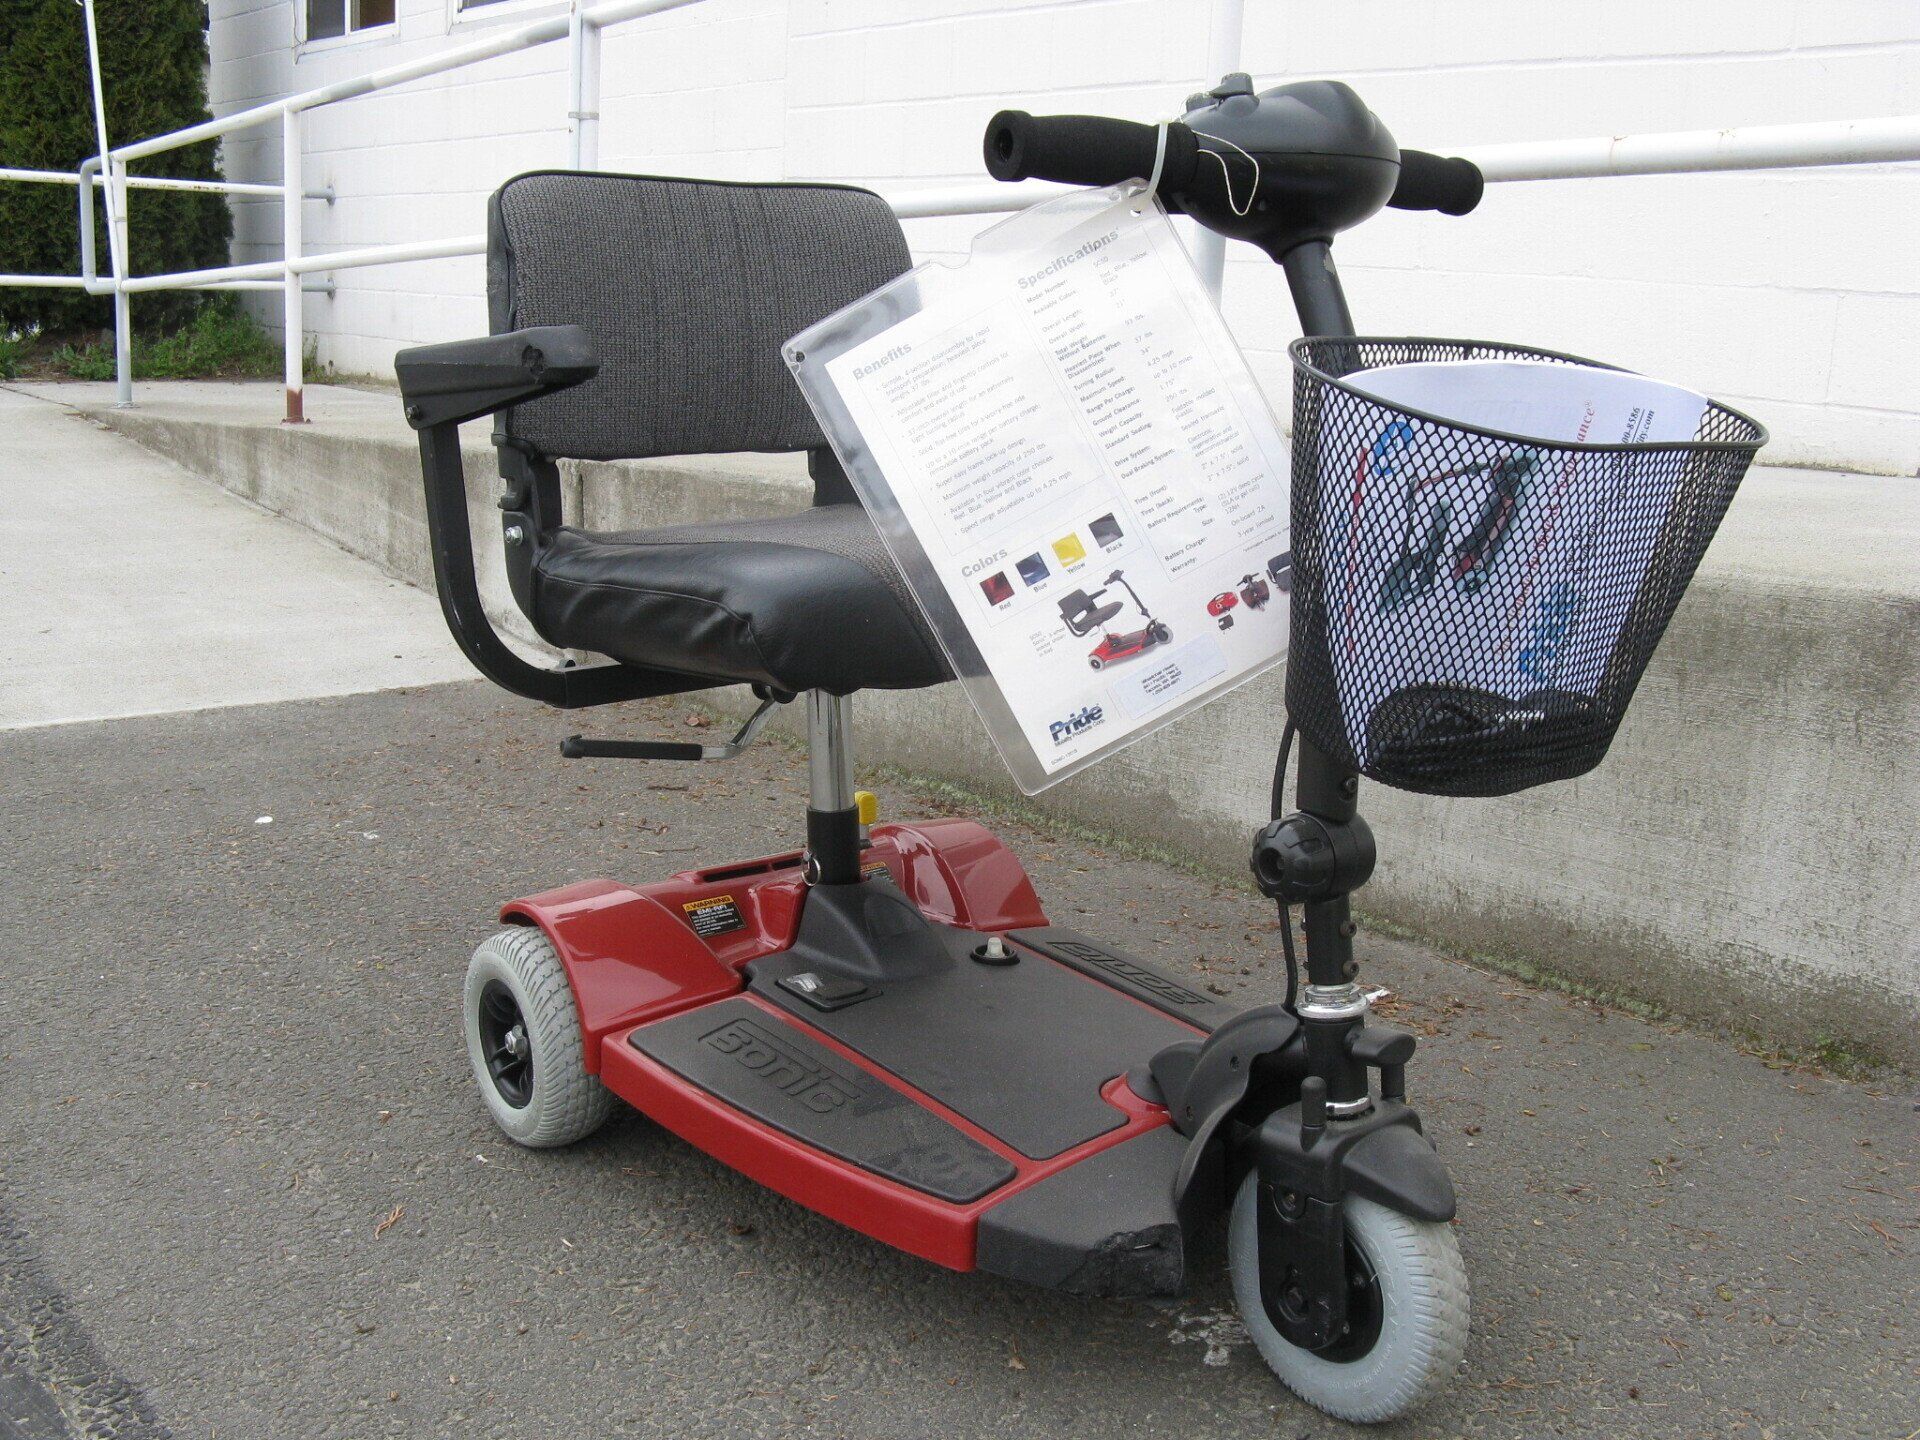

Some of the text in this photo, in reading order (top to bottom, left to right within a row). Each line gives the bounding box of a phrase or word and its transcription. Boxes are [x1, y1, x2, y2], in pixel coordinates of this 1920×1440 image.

[852, 341, 912, 379] Benefits
[960, 546, 1007, 577] Colors
[998, 541, 1122, 610] Red Blue Yellow Black
[1047, 700, 1104, 741] Pride
[690, 896, 731, 909] WARNING
